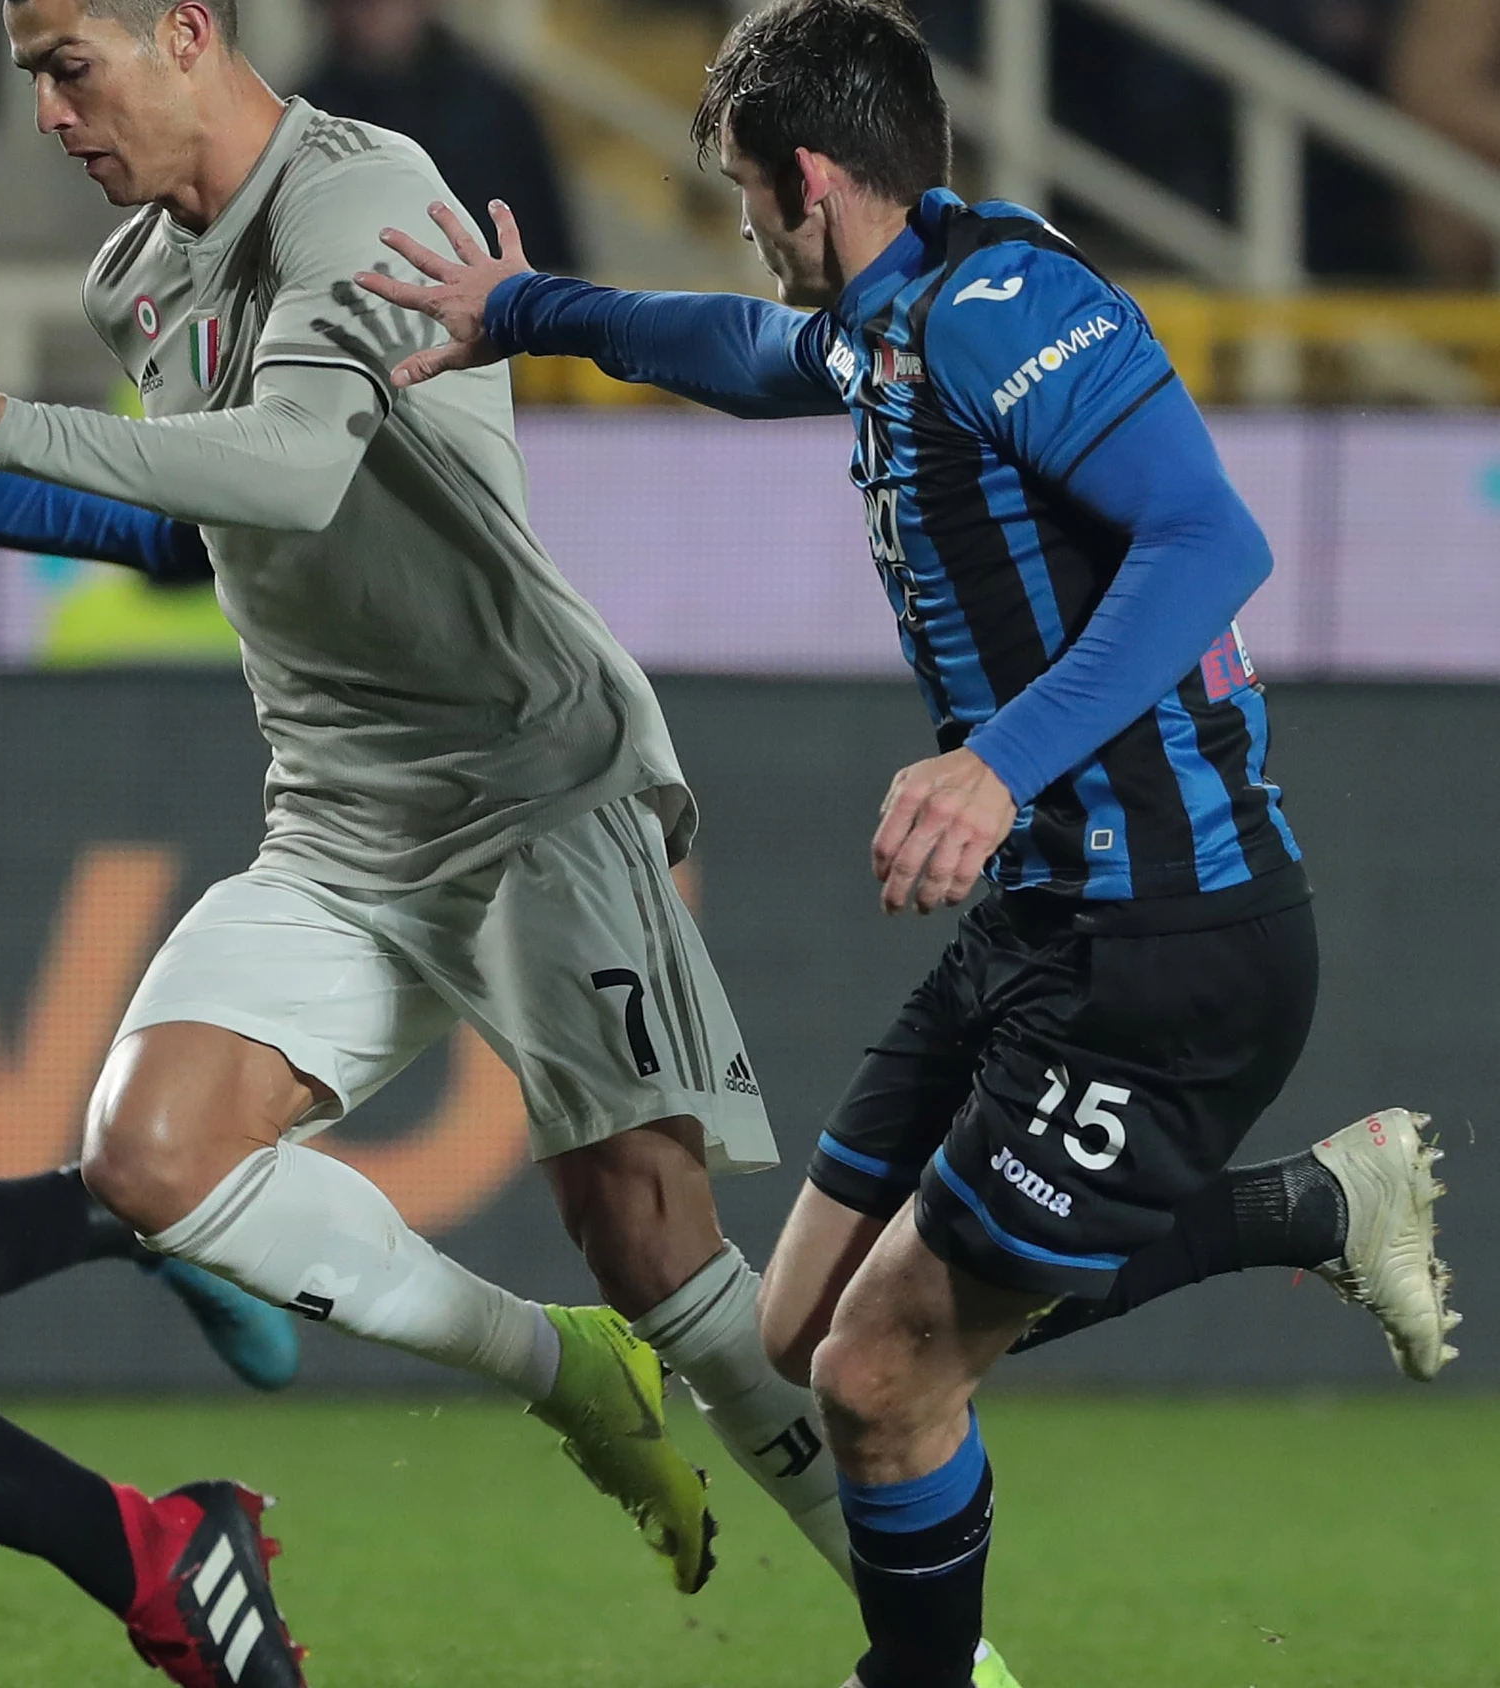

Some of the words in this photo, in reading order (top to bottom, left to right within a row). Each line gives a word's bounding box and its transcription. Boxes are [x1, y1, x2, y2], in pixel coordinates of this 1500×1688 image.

[991, 315, 1119, 417] AUTOMHA
[590, 968, 661, 1078] 7
[1027, 1061, 1132, 1171] 15
[990, 1146, 1073, 1218] Joma
